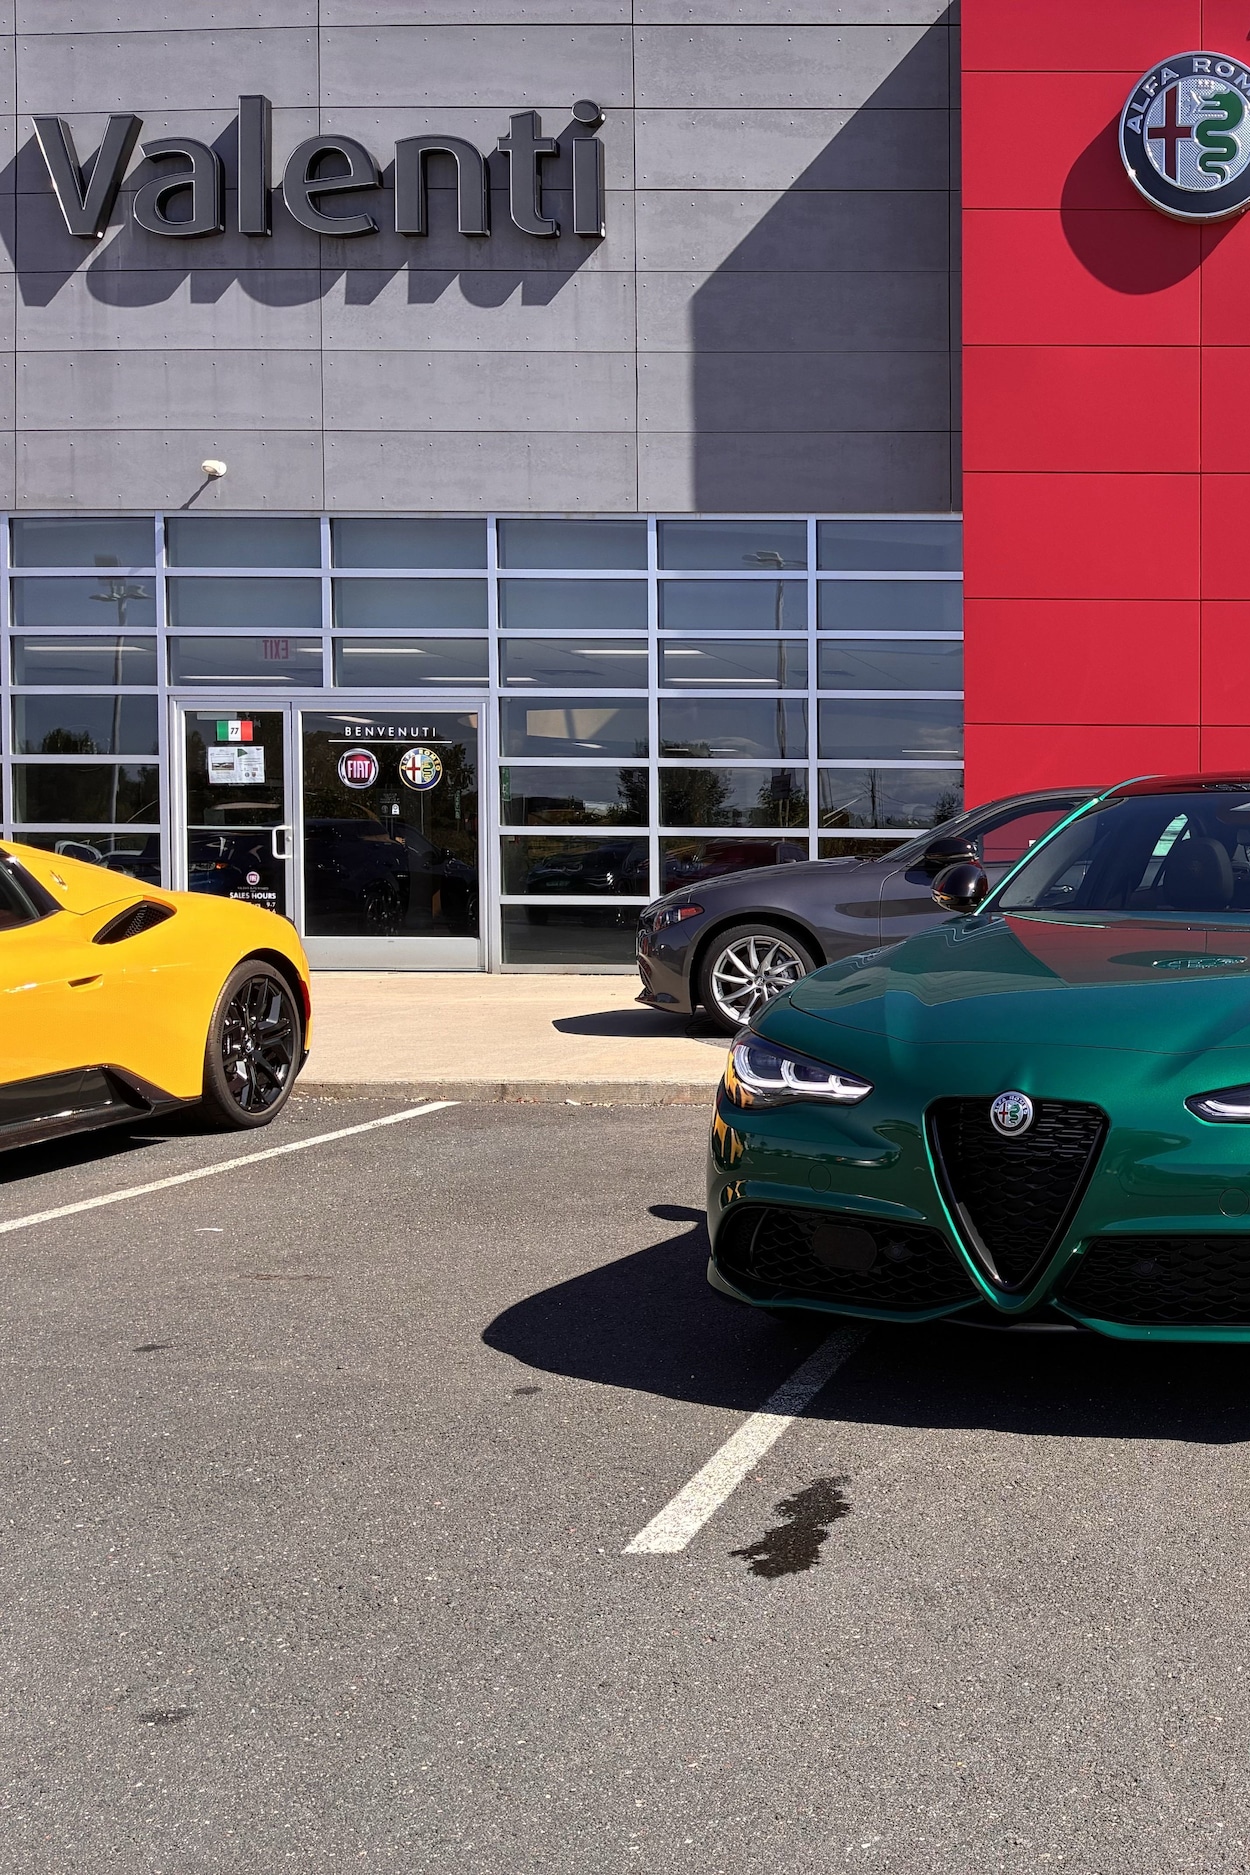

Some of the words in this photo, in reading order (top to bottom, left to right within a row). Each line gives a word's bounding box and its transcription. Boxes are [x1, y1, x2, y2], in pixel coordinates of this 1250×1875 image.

[1126, 67, 1180, 135] ALFA
[31, 94, 606, 239] Valenti
[230, 727, 240, 735] 77
[344, 726, 437, 737] BENVENUTI
[347, 760, 371, 779] FIAT
[401, 751, 416, 771] ALFA
[418, 748, 441, 772] ROMEO
[229, 892, 250, 900] SALES
[251, 892, 277, 900] HOURS
